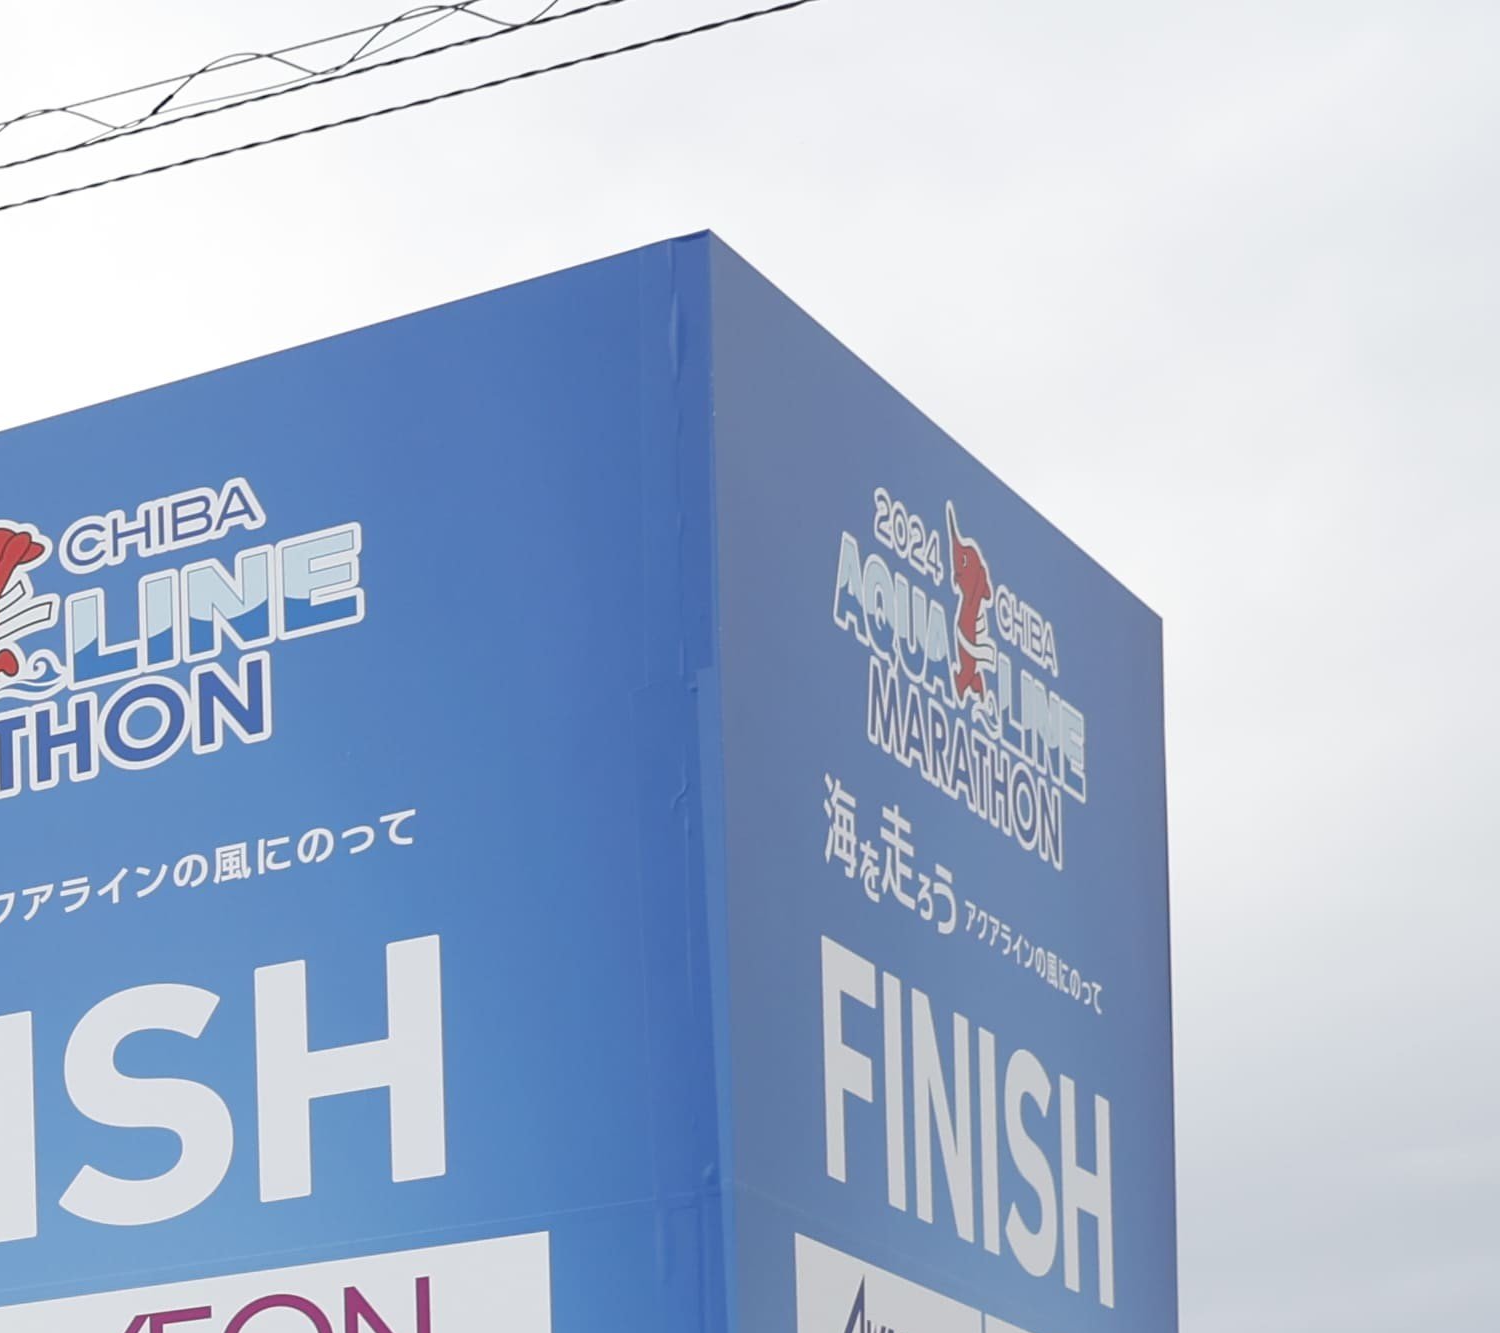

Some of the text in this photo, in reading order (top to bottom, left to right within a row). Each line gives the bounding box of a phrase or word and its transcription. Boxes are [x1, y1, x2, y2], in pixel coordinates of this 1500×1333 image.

[61, 476, 265, 578] CHIBA
[66, 522, 366, 684] LINE
[874, 487, 943, 586] 2024
[995, 583, 1058, 676] CHIBA
[823, 773, 957, 936] 海を走ろう
[867, 676, 1062, 871] MARATHON
[822, 936, 1114, 1309] FINISH
